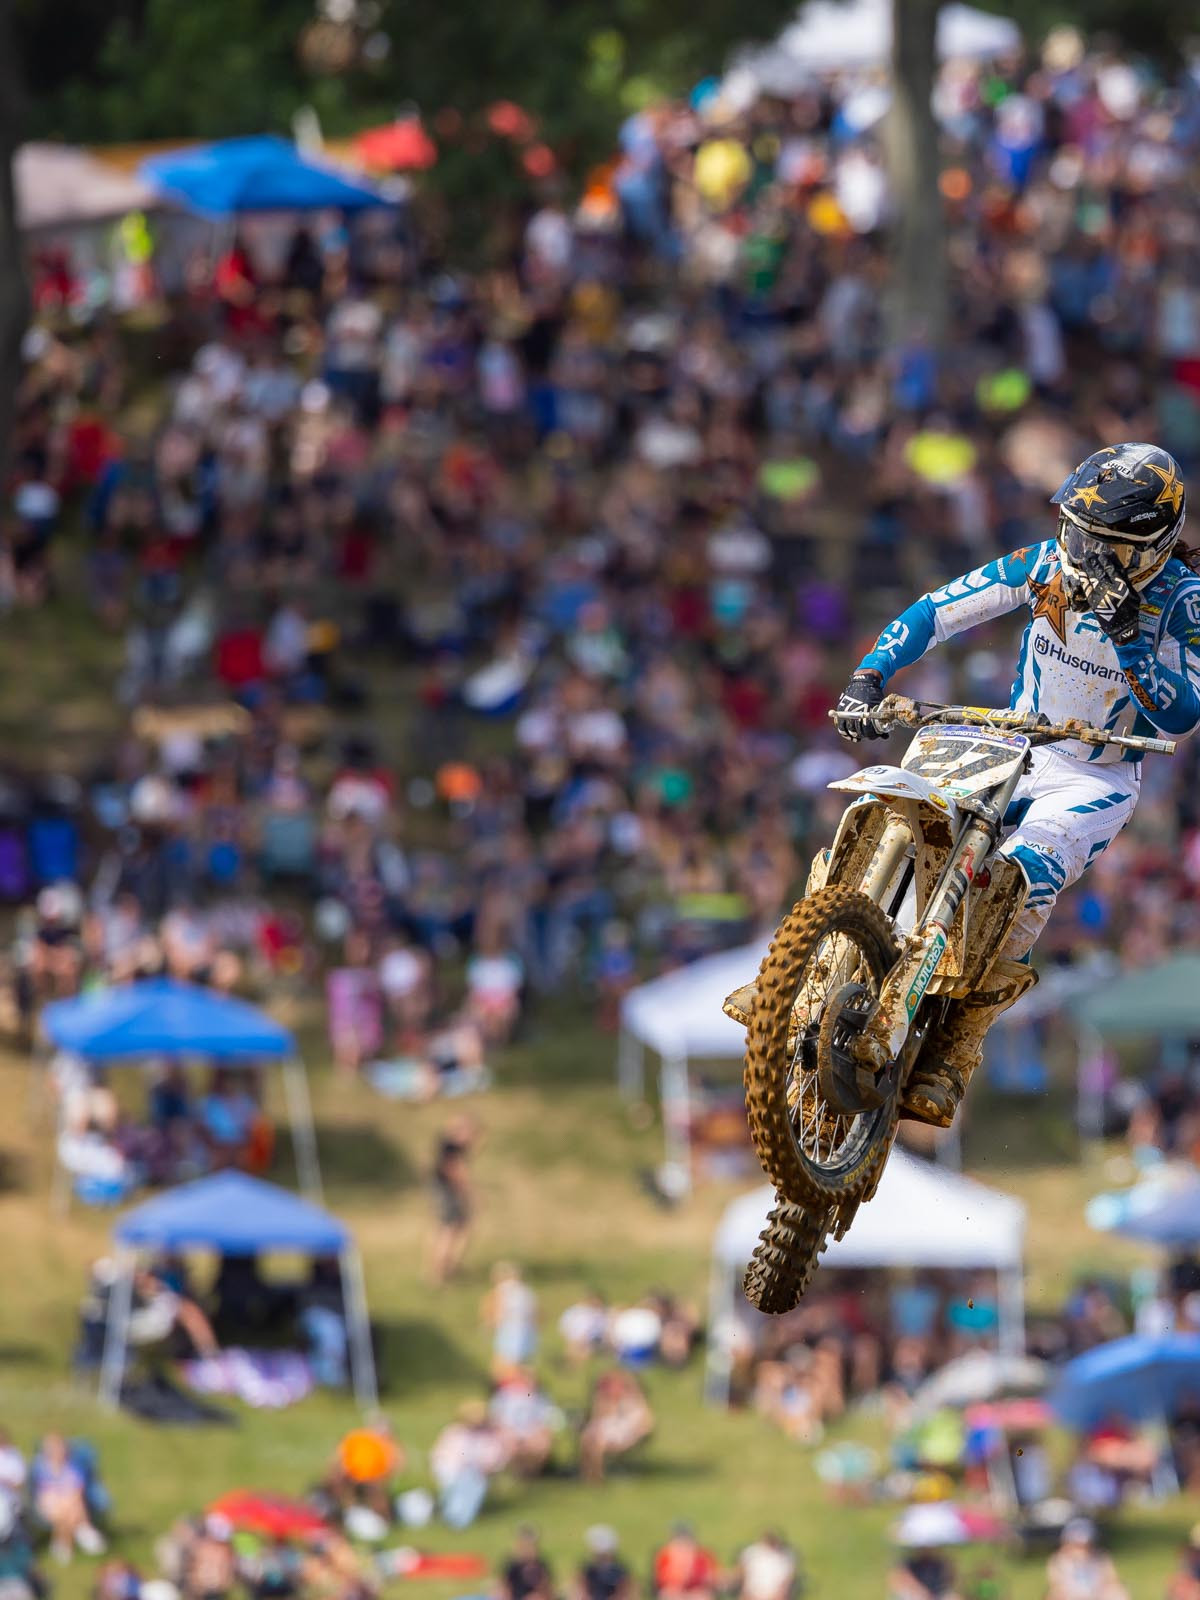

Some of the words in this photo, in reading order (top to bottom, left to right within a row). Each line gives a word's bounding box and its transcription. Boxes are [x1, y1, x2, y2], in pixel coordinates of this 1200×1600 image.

[1125, 668, 1158, 711] OCKSTAR
[903, 739, 1022, 780] 27
[913, 942, 943, 995] MOTOREX
